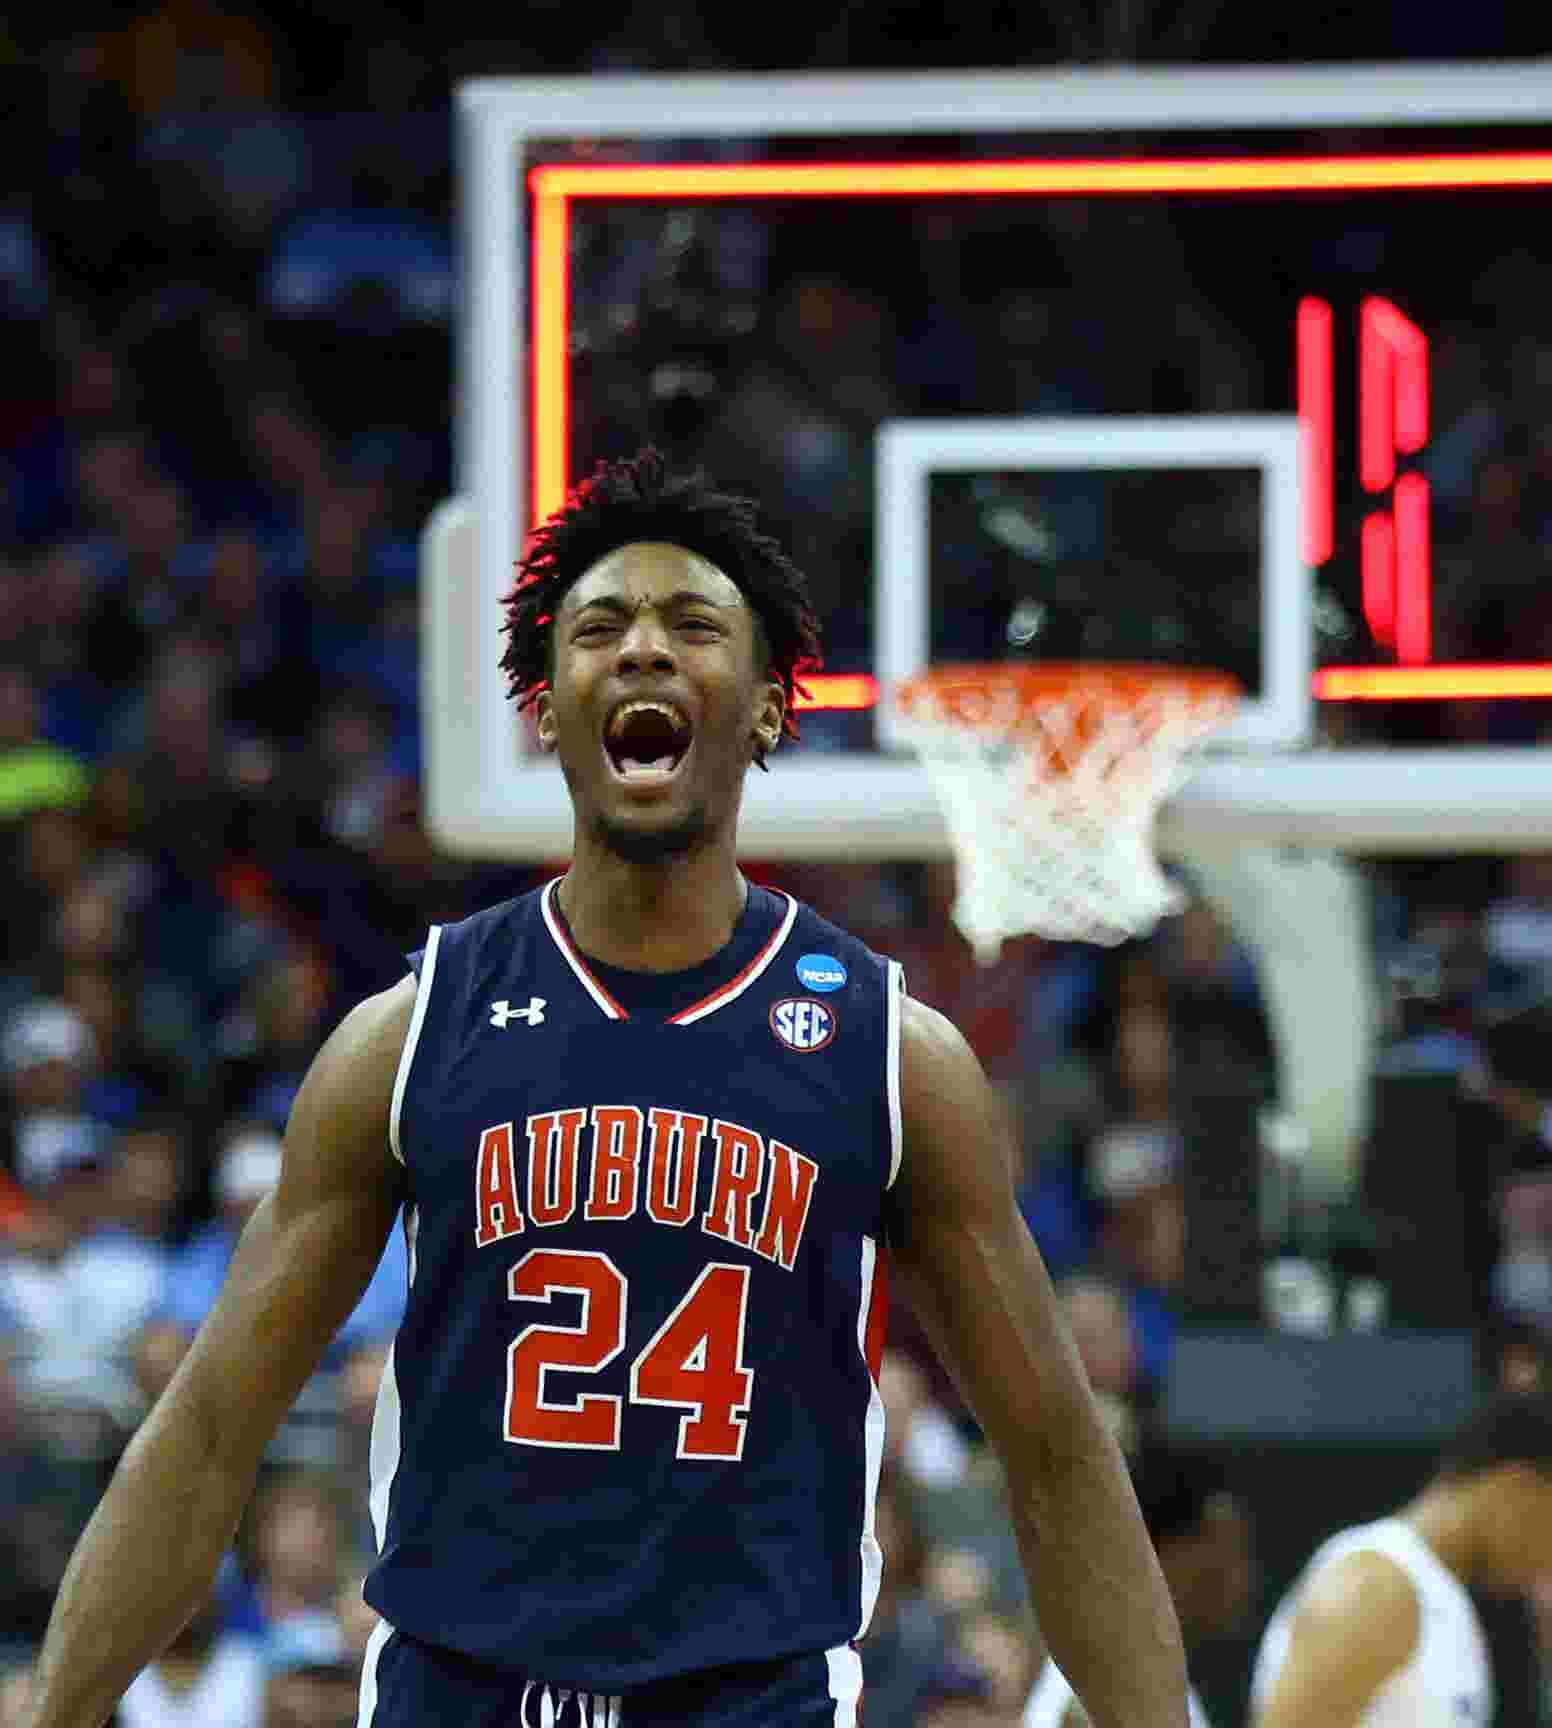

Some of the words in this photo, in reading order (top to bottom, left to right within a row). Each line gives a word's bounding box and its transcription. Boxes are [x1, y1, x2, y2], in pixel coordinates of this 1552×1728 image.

[775, 1001, 831, 1049] SEC
[474, 1104, 820, 1272] AUBURN
[502, 1247, 754, 1461] 24
